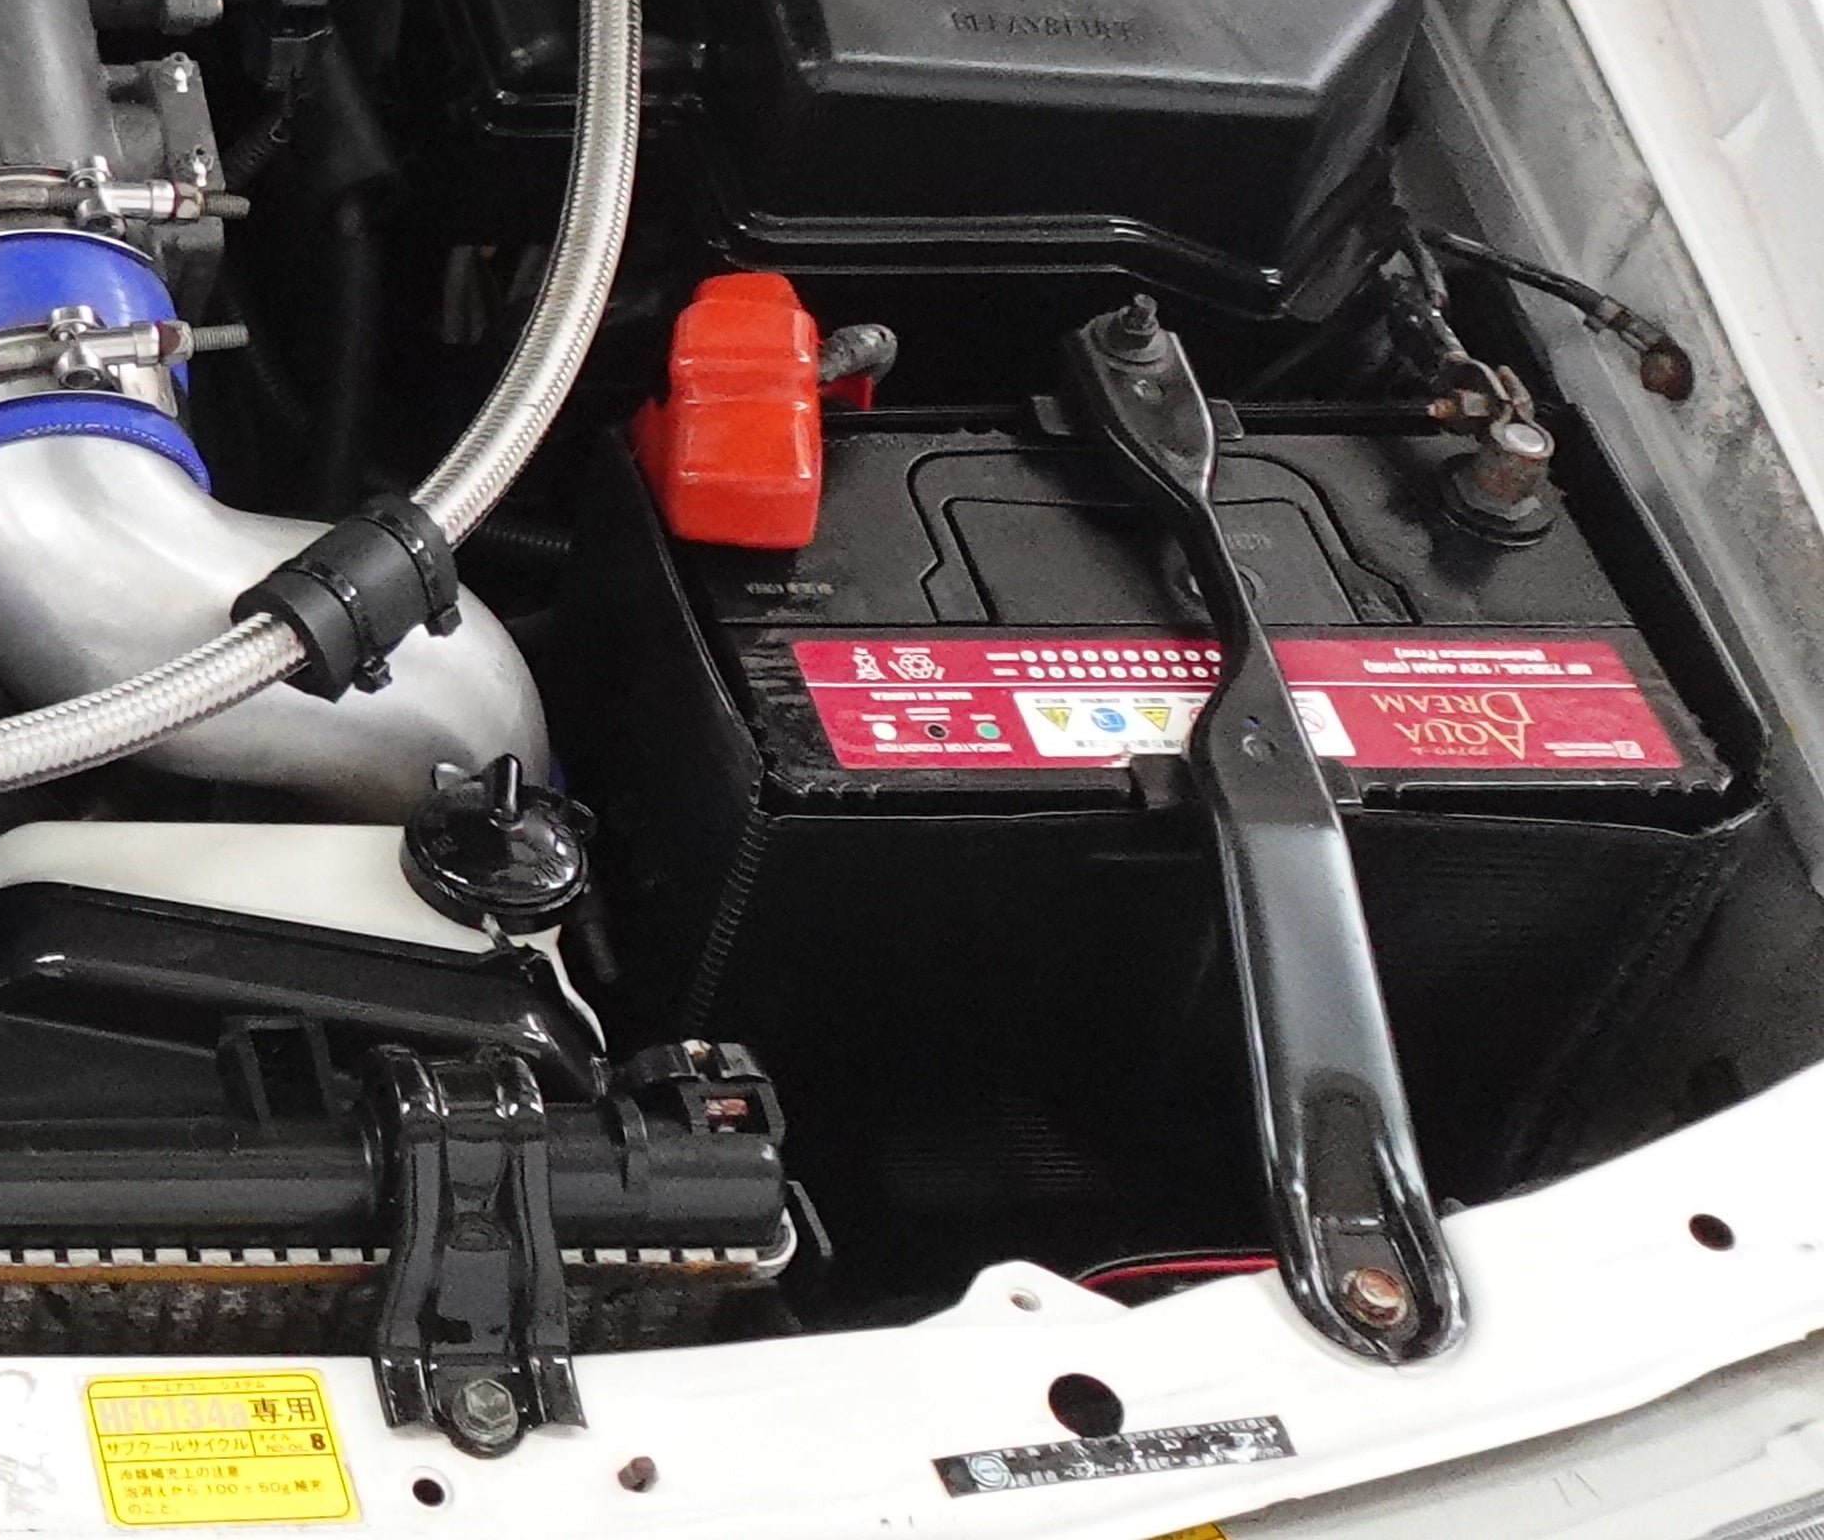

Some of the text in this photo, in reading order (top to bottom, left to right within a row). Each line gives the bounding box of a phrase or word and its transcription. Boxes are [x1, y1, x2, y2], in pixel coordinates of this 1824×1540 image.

[1370, 691, 1535, 725] DREAM
[1394, 718, 1530, 760] AQUA
[96, 1396, 250, 1434] HFC134a
[248, 1396, 318, 1425] 専用
[106, 1437, 250, 1455] サブクールサイクル
[310, 1433, 327, 1451] 8
